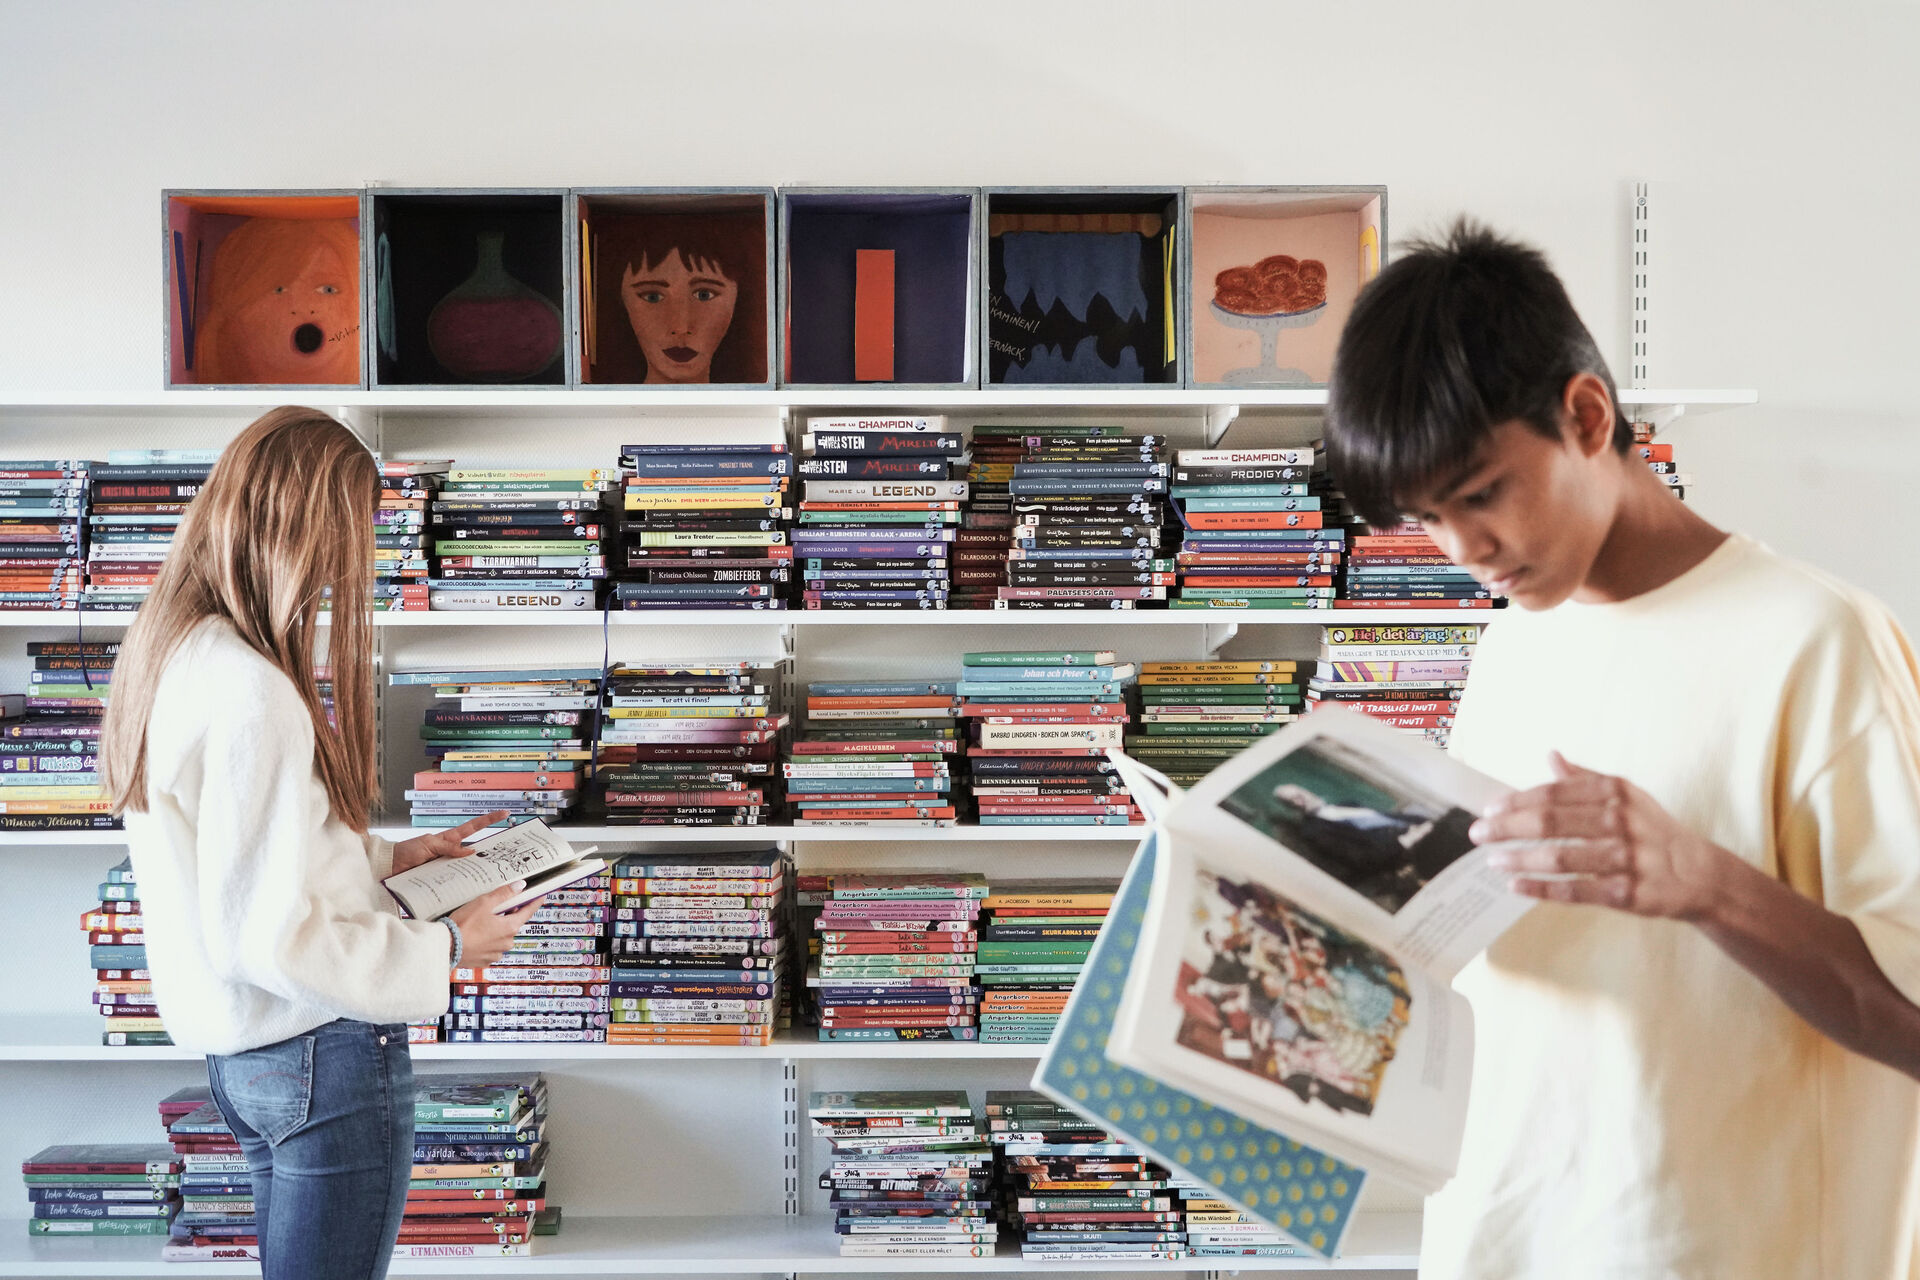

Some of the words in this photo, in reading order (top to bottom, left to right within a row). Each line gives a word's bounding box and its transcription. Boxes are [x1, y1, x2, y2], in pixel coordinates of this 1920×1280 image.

[858, 421, 913, 429] CHAMPION
[841, 435, 865, 449] STEN
[1231, 454, 1287, 462] CHAMPION
[823, 460, 847, 474] STEN
[1231, 469, 1282, 479] PRODIGY
[101, 486, 135, 497] KRISTINA
[137, 486, 171, 497] OHLSSON
[177, 485, 196, 497] MIOS
[872, 486, 937, 497] LEGEND
[480, 556, 538, 567] STORMVARNING
[683, 571, 708, 579] Ohlsson
[713, 570, 761, 581] ZOMBIEFEBER
[1046, 589, 1092, 597] PALATSETS
[1093, 587, 1114, 596] GÅTA
[497, 595, 562, 606] LEGEND
[1353, 628, 1381, 643] Hej,
[1382, 628, 1405, 642] det
[1406, 628, 1422, 641] är
[1421, 628, 1450, 643] jag!
[1021, 669, 1045, 679] Johan
[1046, 670, 1061, 678] och
[410, 675, 451, 685] Pocahontas
[691, 696, 711, 704] finns!
[1366, 703, 1410, 713] TRASSLIGT
[1411, 703, 1437, 712] INUTI
[435, 714, 505, 722] MINNESBANKEN
[1398, 717, 1424, 726] INUTI
[1011, 731, 1038, 739] LINDGREN
[39, 756, 82, 772] NIKKIS
[615, 794, 642, 802] ULRIKA
[84, 818, 90, 827] 2
[565, 893, 591, 901] KINNEY
[722, 911, 748, 919] KINNEY
[726, 925, 751, 933] KINNEY
[550, 941, 575, 949] KINNEY
[558, 955, 581, 963] KINNEY
[564, 970, 589, 978] KINNEY
[901, 1029, 919, 1037] NINJA
[444, 1132, 468, 1142] Spring
[484, 1132, 507, 1140] vinden
[426, 1149, 456, 1159] världar
[222, 1164, 245, 1173] Kerrys
[192, 1202, 217, 1211] NANCY
[217, 1202, 252, 1211] SPRINGER
[212, 1249, 248, 1258] DUNDER
[410, 1246, 475, 1257] UTMANINGEN
